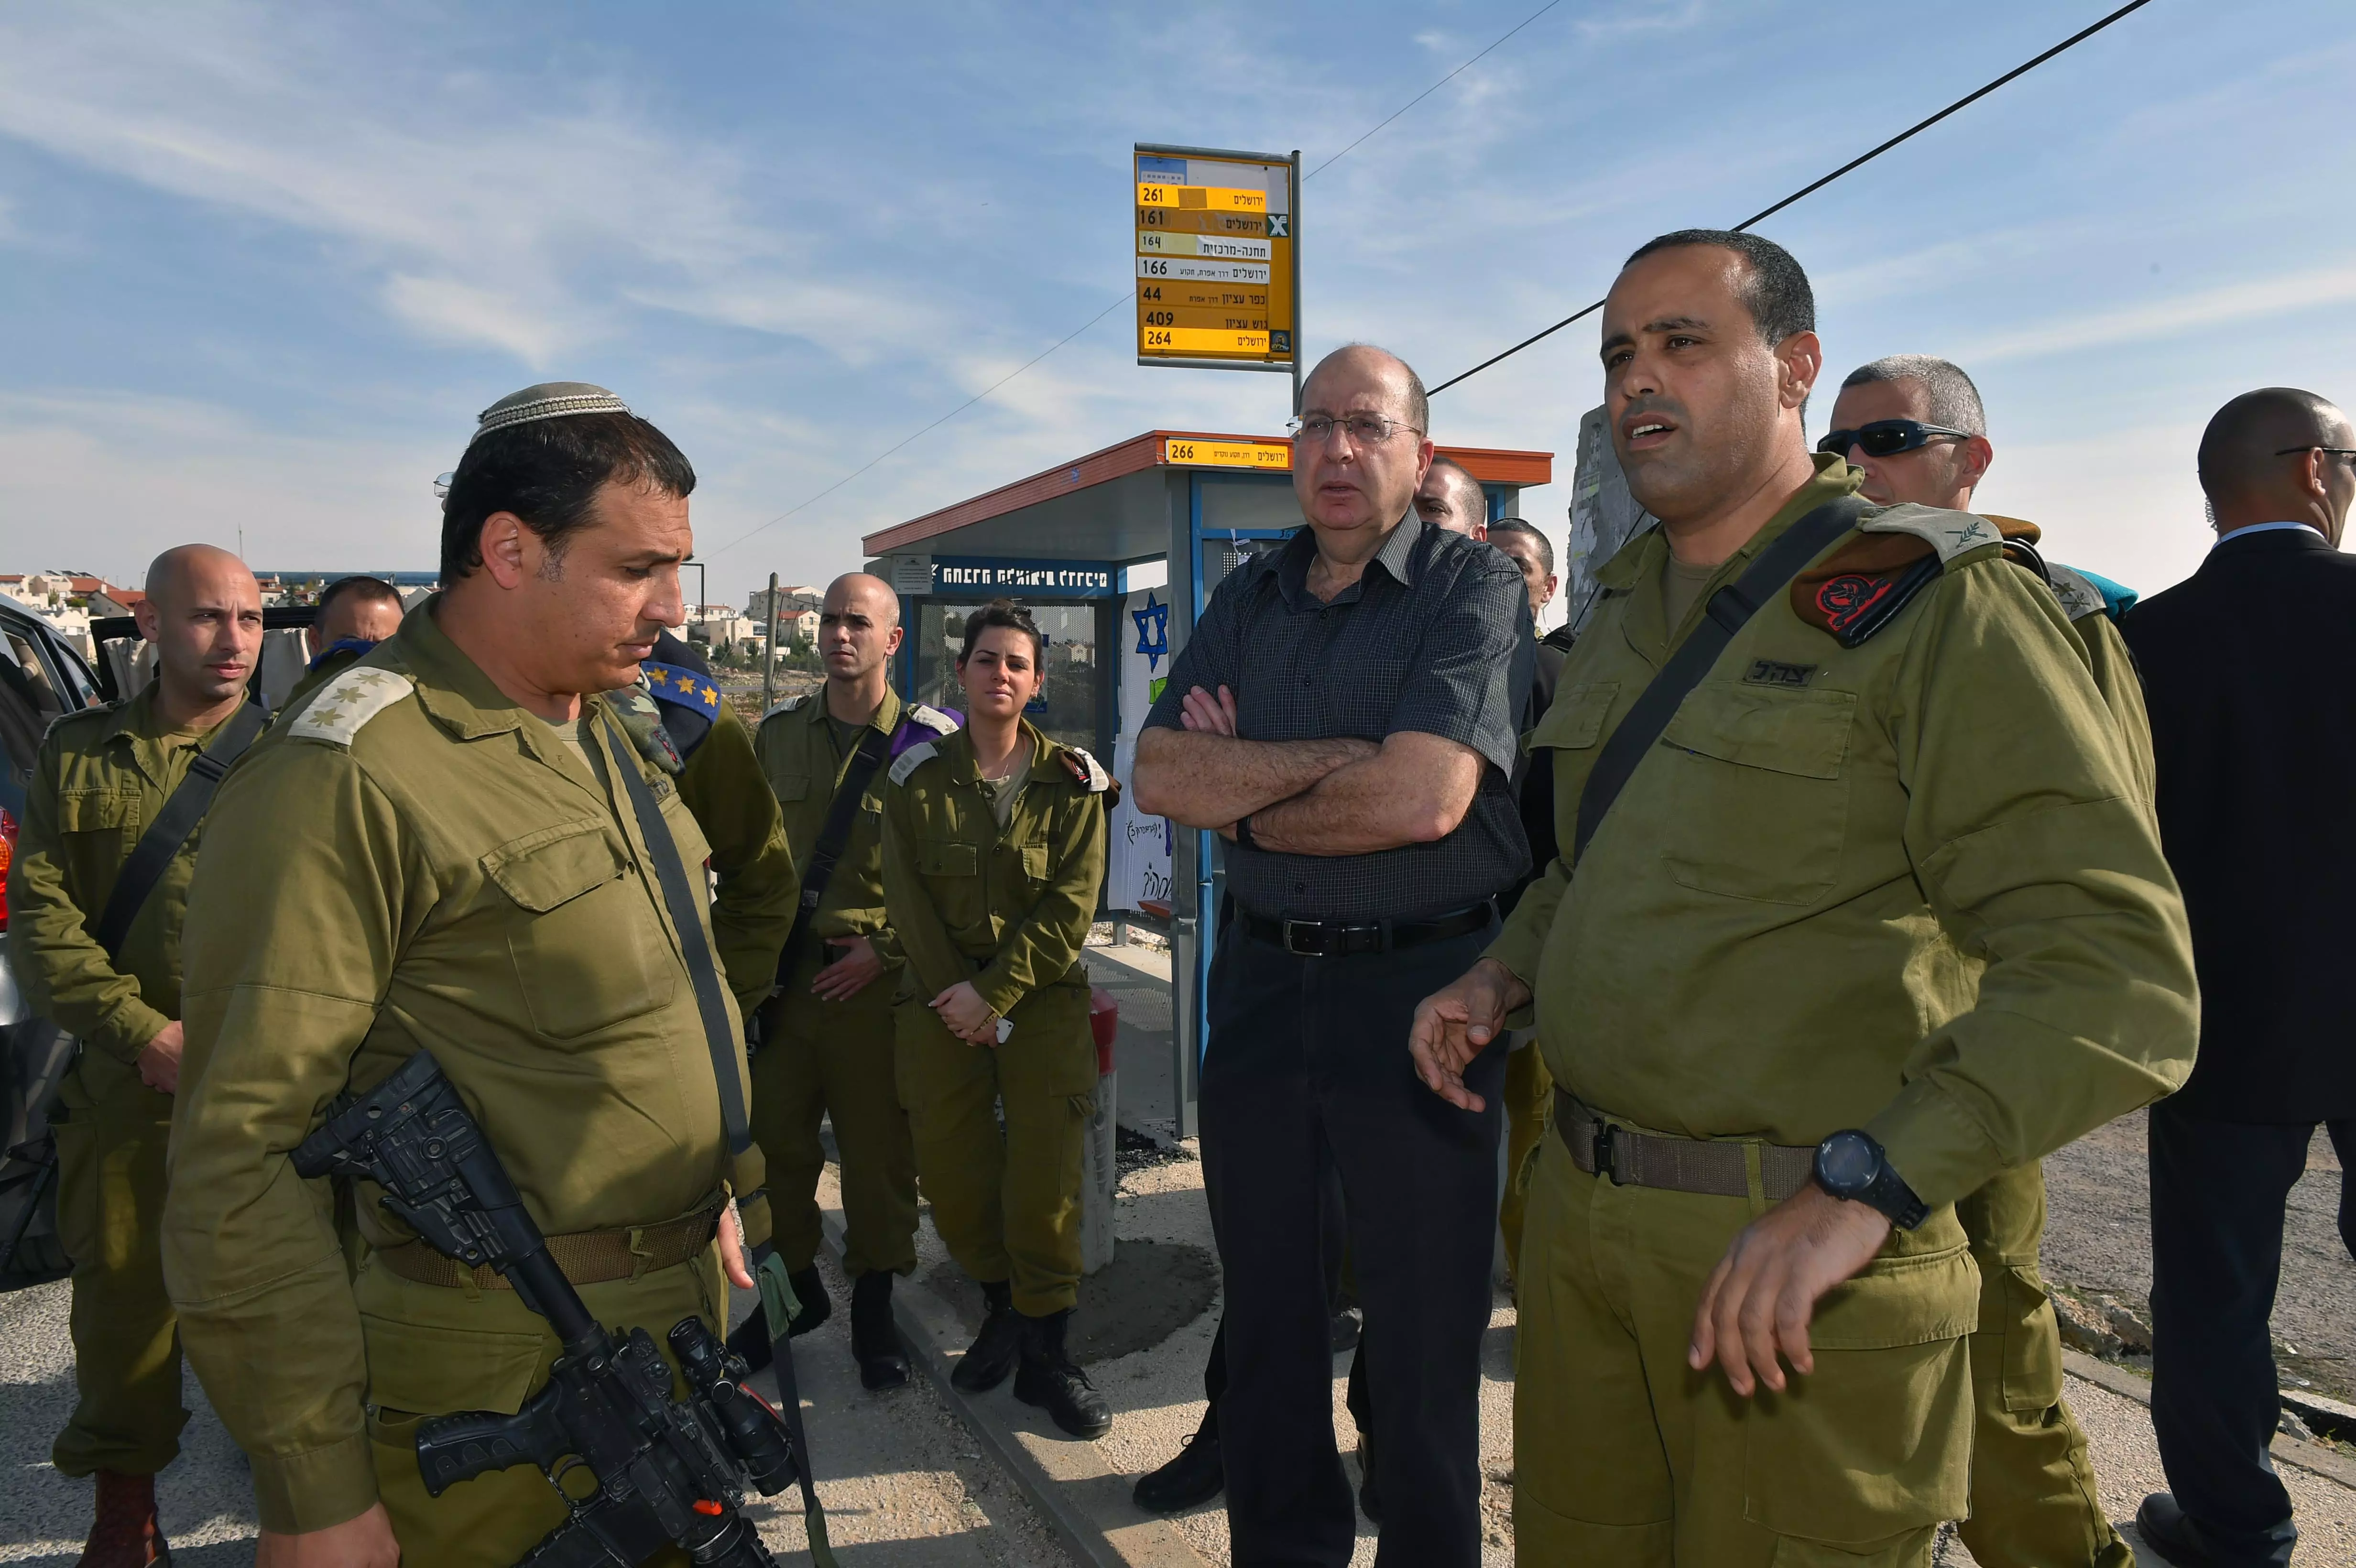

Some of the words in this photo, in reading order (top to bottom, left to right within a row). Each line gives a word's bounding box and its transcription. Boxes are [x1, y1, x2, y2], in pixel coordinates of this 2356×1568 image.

[1143, 187, 1163, 202] 261
[1233, 194, 1263, 206] ירושלים
[1140, 209, 1163, 225] 161
[1225, 218, 1262, 231] ירושלים
[1143, 236, 1161, 249] 164
[1203, 244, 1266, 258] תחנה-מרכזית
[1143, 260, 1167, 275] 166
[1233, 268, 1266, 280] ירושלים
[1143, 287, 1161, 301] 44
[1222, 294, 1244, 305] עציון
[1249, 295, 1265, 305] כפר
[1146, 311, 1174, 326] 409
[1225, 318, 1248, 329] עציון
[1252, 320, 1267, 329] גוש
[1147, 331, 1171, 345] 264
[1237, 336, 1266, 347] ירושלים
[1172, 444, 1194, 459] 266
[1257, 450, 1285, 462] ירושלים
